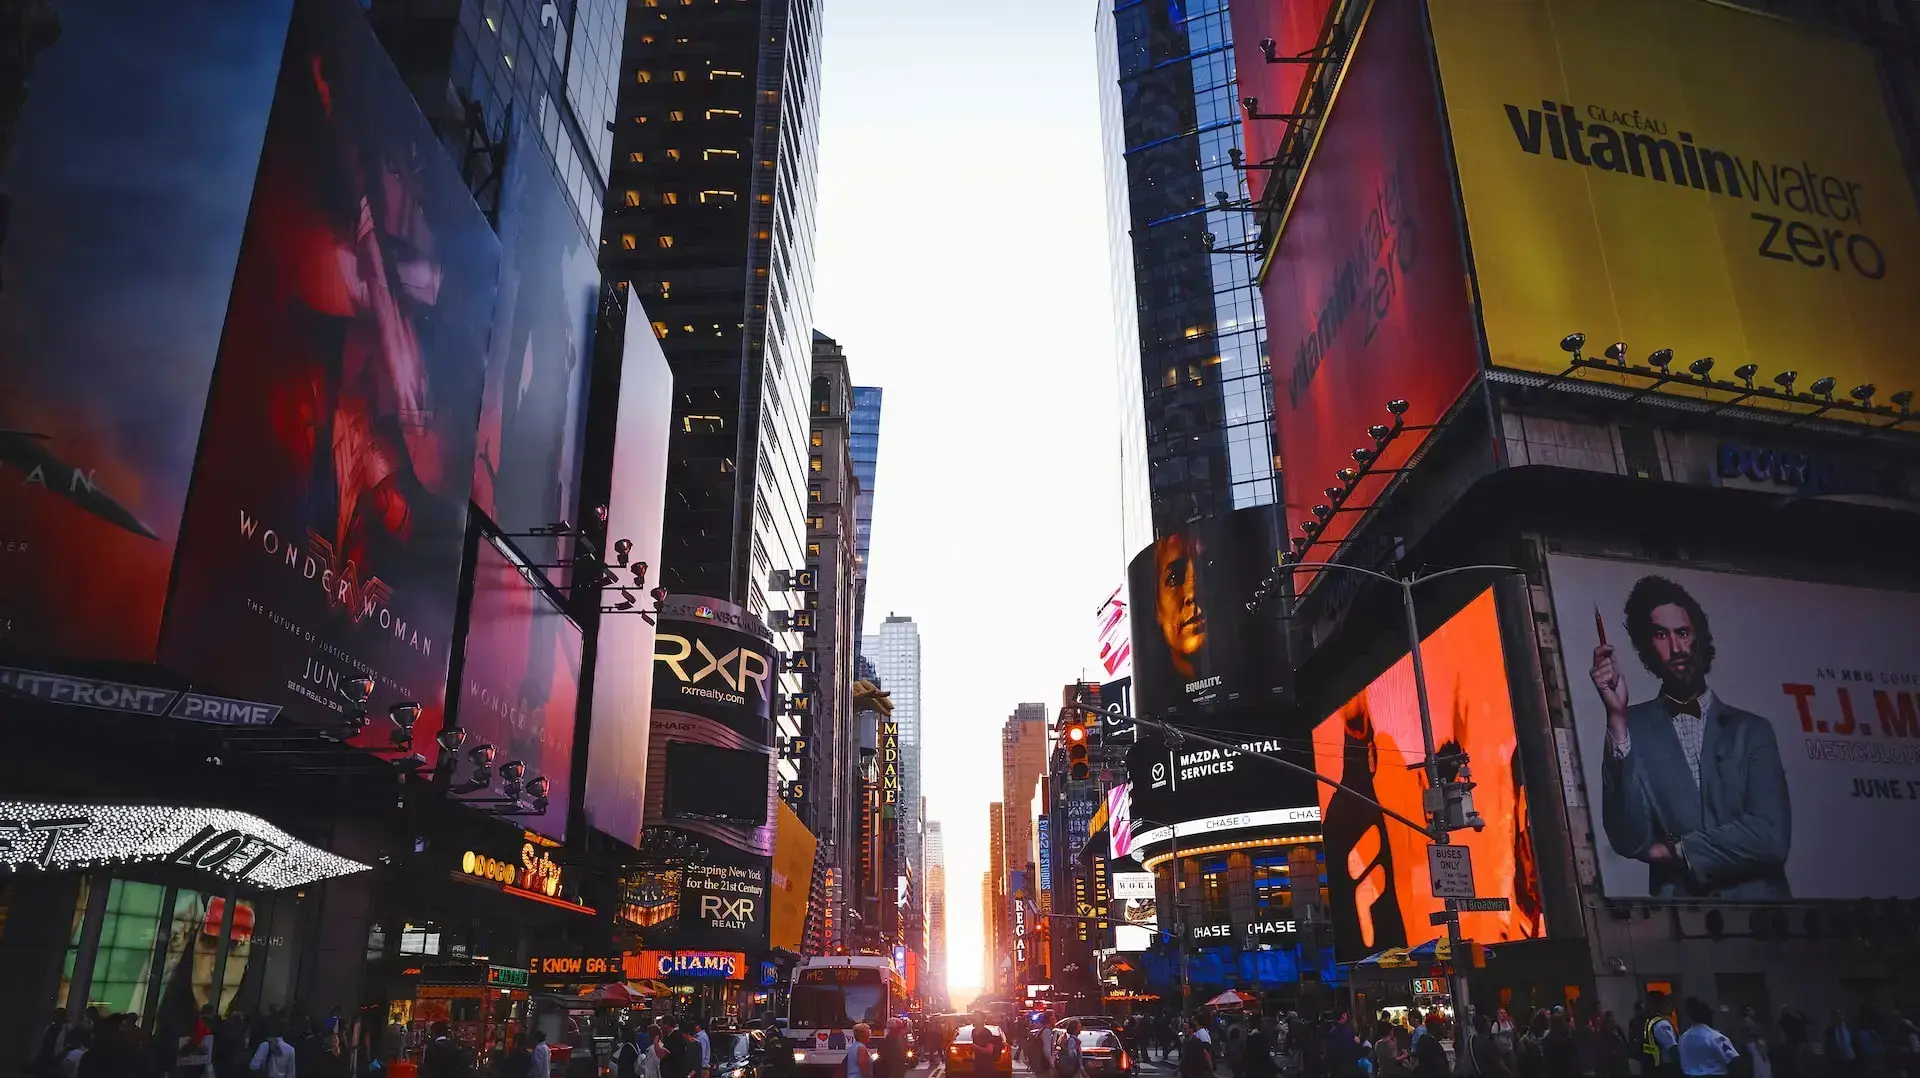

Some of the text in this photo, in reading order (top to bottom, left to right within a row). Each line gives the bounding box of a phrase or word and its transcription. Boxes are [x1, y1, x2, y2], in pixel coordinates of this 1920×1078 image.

[1587, 104, 1668, 136] GLACÉAU
[1503, 99, 1862, 225] vitaminwater
[1751, 212, 1887, 281] zero
[1365, 216, 1419, 347] zero
[239, 509, 351, 604] WONDER
[364, 595, 432, 658] WOMAN
[247, 598, 264, 615] THE
[269, 611, 301, 636] FUTURE
[305, 632, 316, 643] OF
[319, 641, 350, 663] JUSTICE
[353, 659, 378, 680] BEGINS
[302, 657, 345, 692] JUN
[655, 633, 769, 702] RXR
[1817, 668, 1836, 680] AN
[1842, 669, 1874, 682] HBO
[681, 685, 745, 704] rxrrealty.com
[794, 572, 811, 798] CHAMPS
[1185, 675, 1222, 694] EQUALITY.
[184, 697, 270, 725] PRIME
[1781, 683, 1920, 738] T.J. M
[650, 721, 696, 731] SHARP
[884, 722, 898, 803] MADAME
[1180, 748, 1221, 767] MAZDA
[1181, 760, 1235, 781] SERVICES
[1851, 778, 1903, 799] JUNE
[1040, 832, 1049, 848] 42
[1152, 828, 1172, 841] CHASE
[1206, 817, 1240, 830] CHASE
[175, 825, 288, 880] LOFT
[1436, 849, 1462, 859] BUSES
[729, 866, 747, 878] New
[748, 868, 762, 881] York
[1440, 861, 1460, 870] ONLY
[686, 877, 764, 898] for the 21st Century
[1095, 856, 1106, 901] VICTORY
[700, 895, 755, 922] RXR
[1469, 901, 1507, 910] Broadway
[711, 919, 747, 929] REALTY
[1015, 900, 1025, 962] REGAL
[1248, 921, 1297, 935] CHASE
[543, 957, 582, 973] KNOW
[586, 957, 621, 973] GAE
[657, 956, 736, 975] CHAMPS
[1414, 980, 1440, 993] SODA
